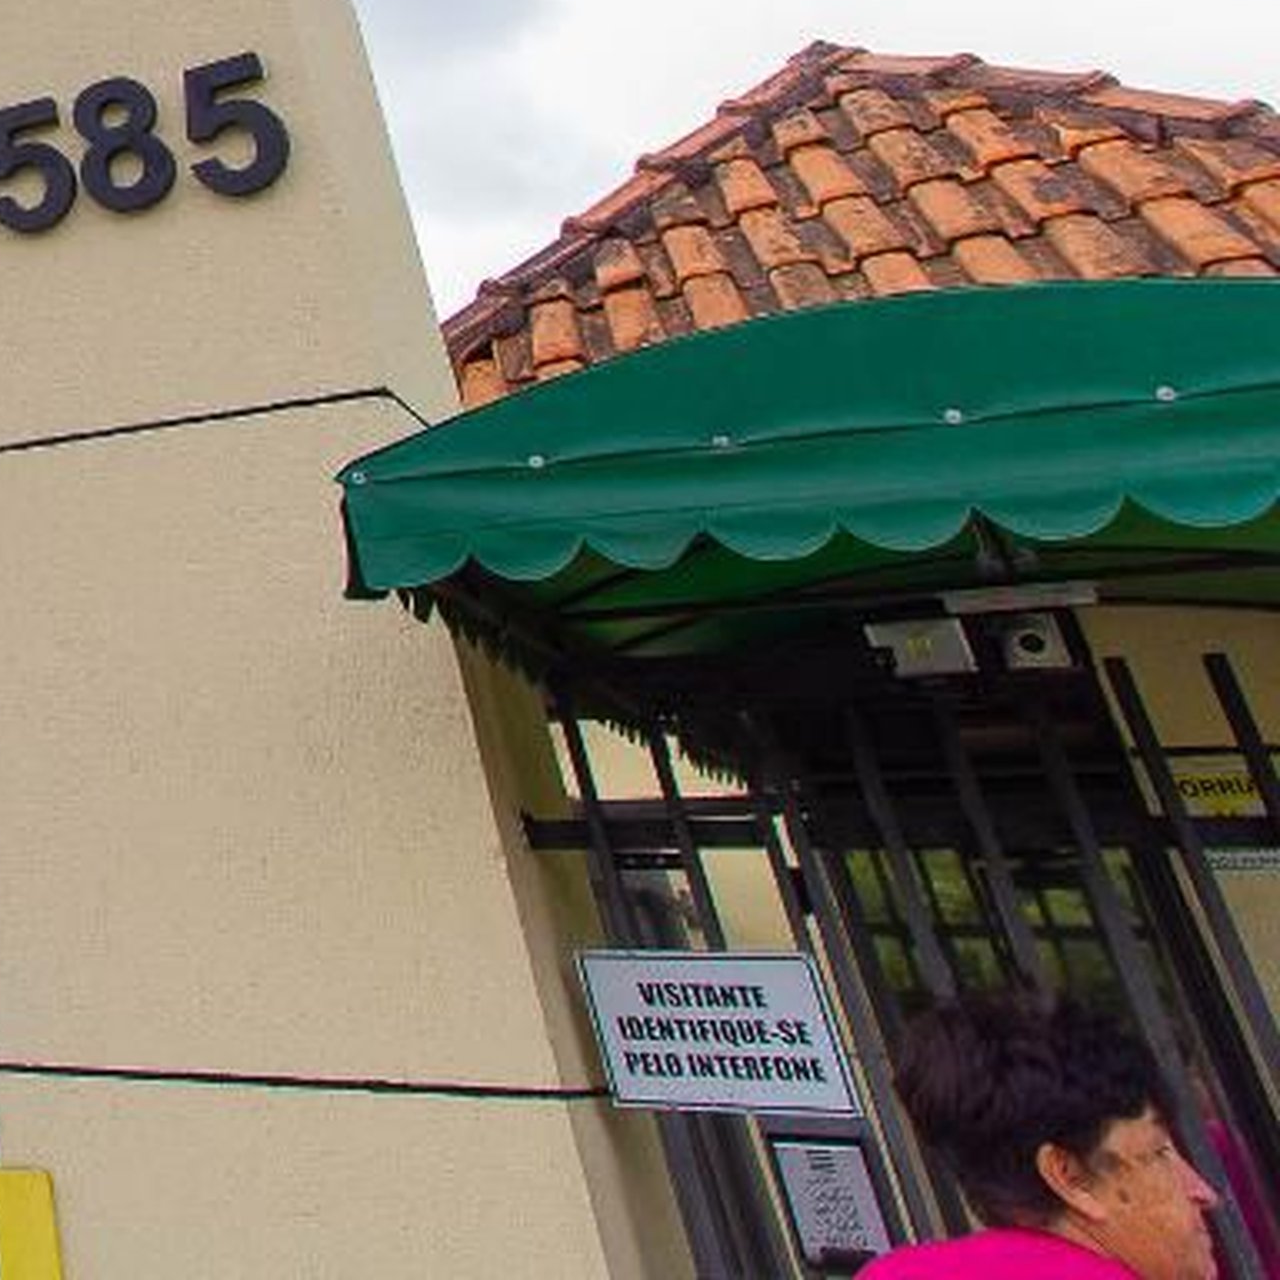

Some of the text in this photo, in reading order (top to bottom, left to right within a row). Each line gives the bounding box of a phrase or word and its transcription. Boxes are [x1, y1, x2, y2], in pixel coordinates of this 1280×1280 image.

[636, 982, 768, 1009] VISITANTE
[616, 1015, 814, 1048] IDENTIFIQUE-SE
[623, 1051, 828, 1083] PELO INTERFONE
